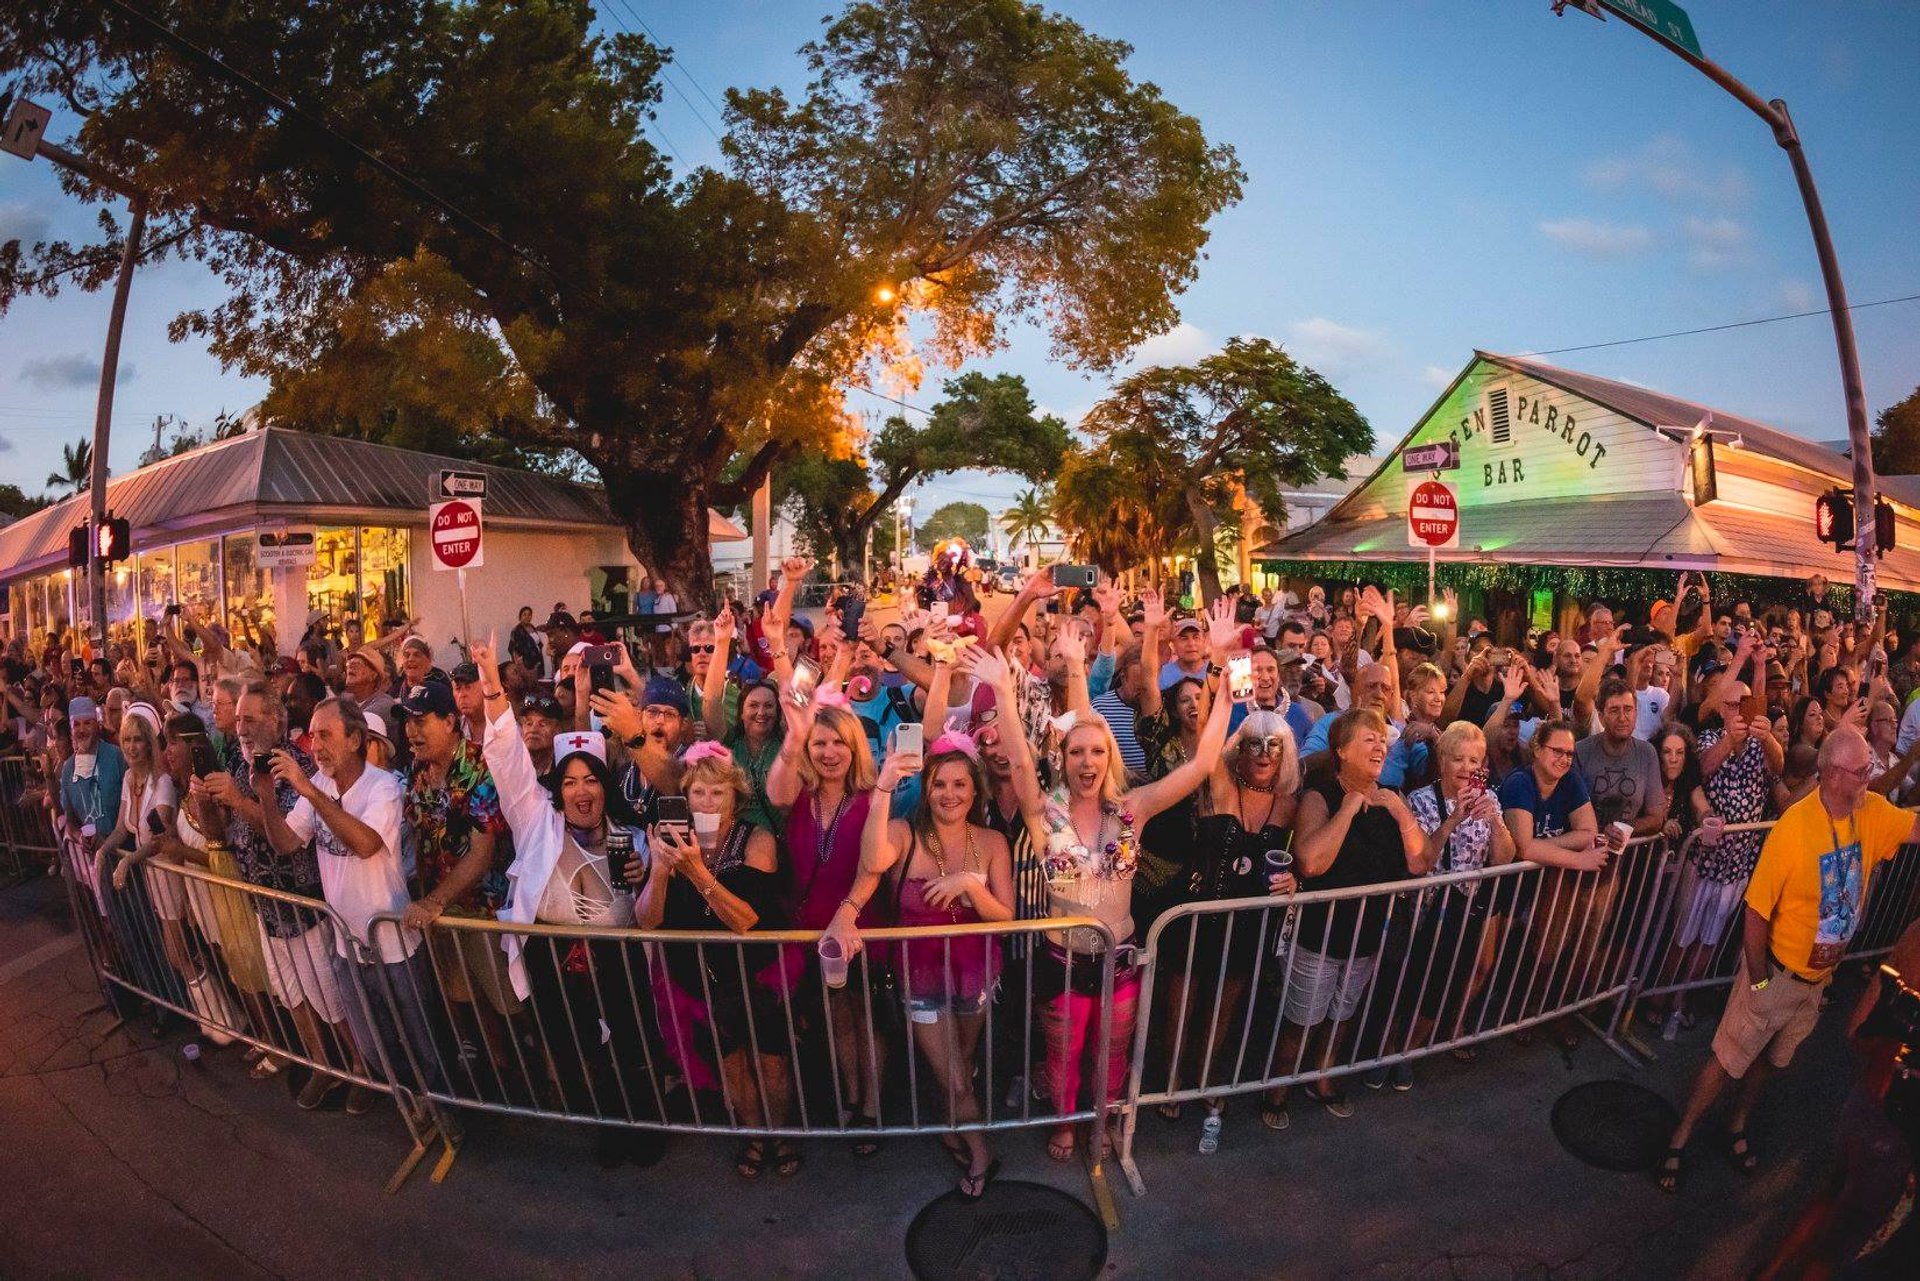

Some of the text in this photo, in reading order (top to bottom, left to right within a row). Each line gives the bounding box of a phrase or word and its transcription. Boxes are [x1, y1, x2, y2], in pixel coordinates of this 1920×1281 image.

[1517, 396, 1606, 469] PARROT
[1406, 451, 1436, 465] ONE WAY
[1484, 458, 1525, 487] BAR
[454, 479, 483, 491] ONE WAY
[1416, 493, 1451, 506] DO NOT
[438, 512, 473, 526] DO NOT
[1419, 523, 1449, 535] ENTER
[443, 542, 471, 555] ENTER
